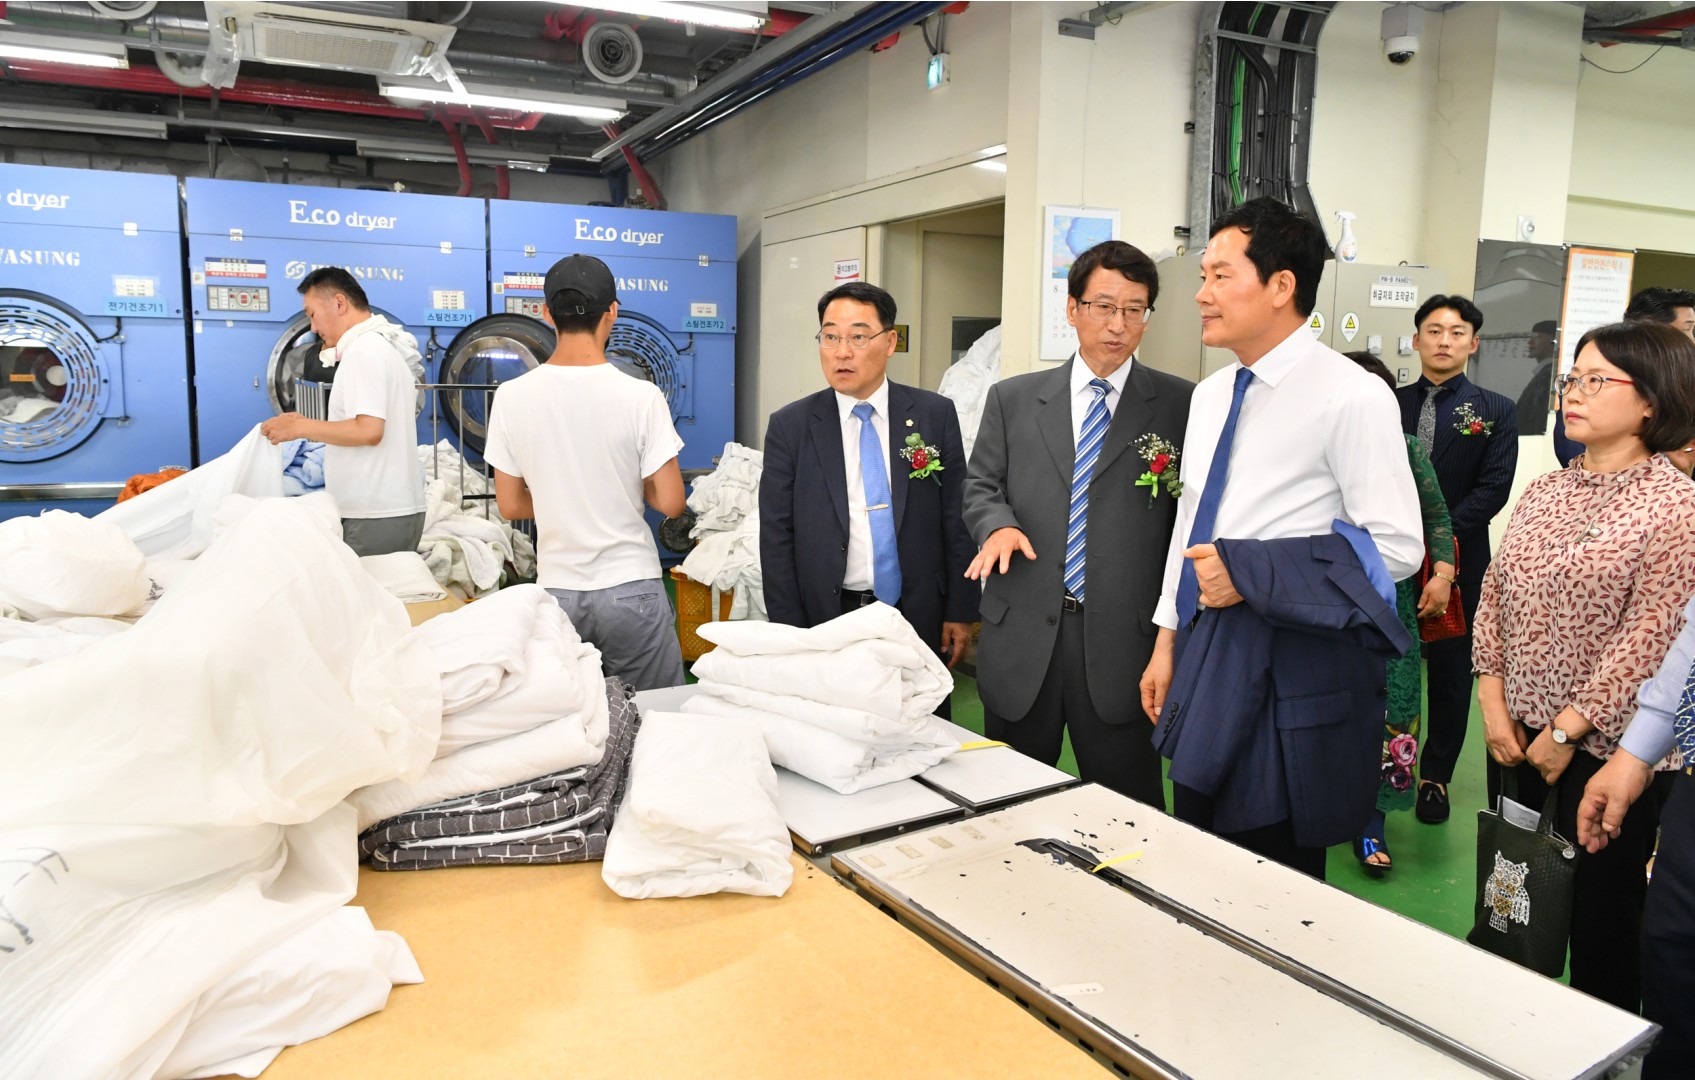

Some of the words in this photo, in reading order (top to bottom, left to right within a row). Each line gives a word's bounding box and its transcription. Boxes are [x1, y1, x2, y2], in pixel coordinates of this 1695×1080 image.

[6, 188, 70, 211] dryer
[288, 199, 341, 226] Eco
[345, 210, 398, 232] dryer
[574, 218, 618, 242] Eco
[620, 228, 665, 247] dryer
[0, 248, 80, 267] ASUNG
[311, 264, 404, 281] SUNG
[614, 277, 669, 292] ASUNG
[1054, 285, 1058, 293] 8
[1395, 291, 1414, 302] 조작금지
